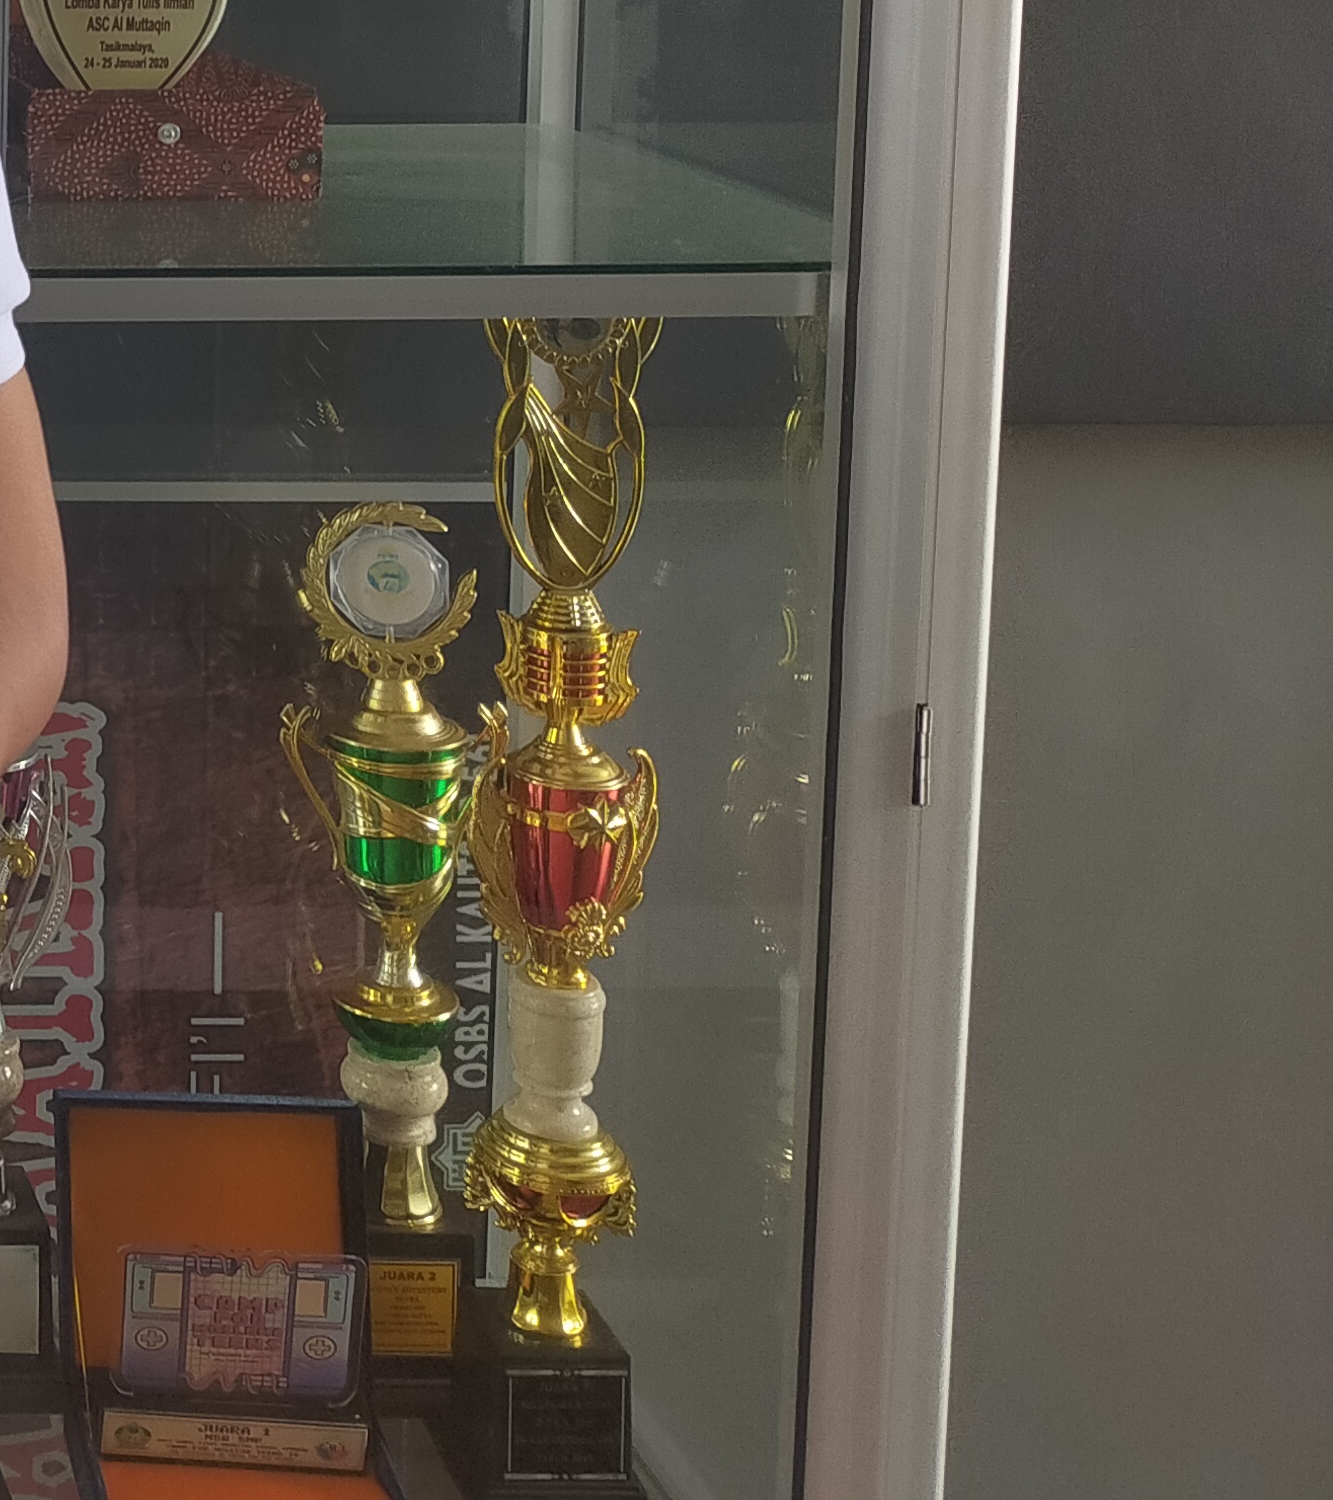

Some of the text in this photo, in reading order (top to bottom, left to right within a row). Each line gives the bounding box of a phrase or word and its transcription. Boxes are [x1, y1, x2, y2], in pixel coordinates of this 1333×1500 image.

[86, 16, 110, 32] ASC
[125, 16, 171, 35] Muttaqin
[84, 57, 95, 69] 24
[101, 57, 113, 69] 25
[114, 57, 147, 69] Januari
[148, 57, 170, 69] 2020
[455, 952, 492, 995] AL
[453, 1005, 490, 1089] OSBS
[379, 1271, 425, 1282] JUARA
[195, 1294, 284, 1314] CAMP
[198, 1424, 251, 1436] JUARA
